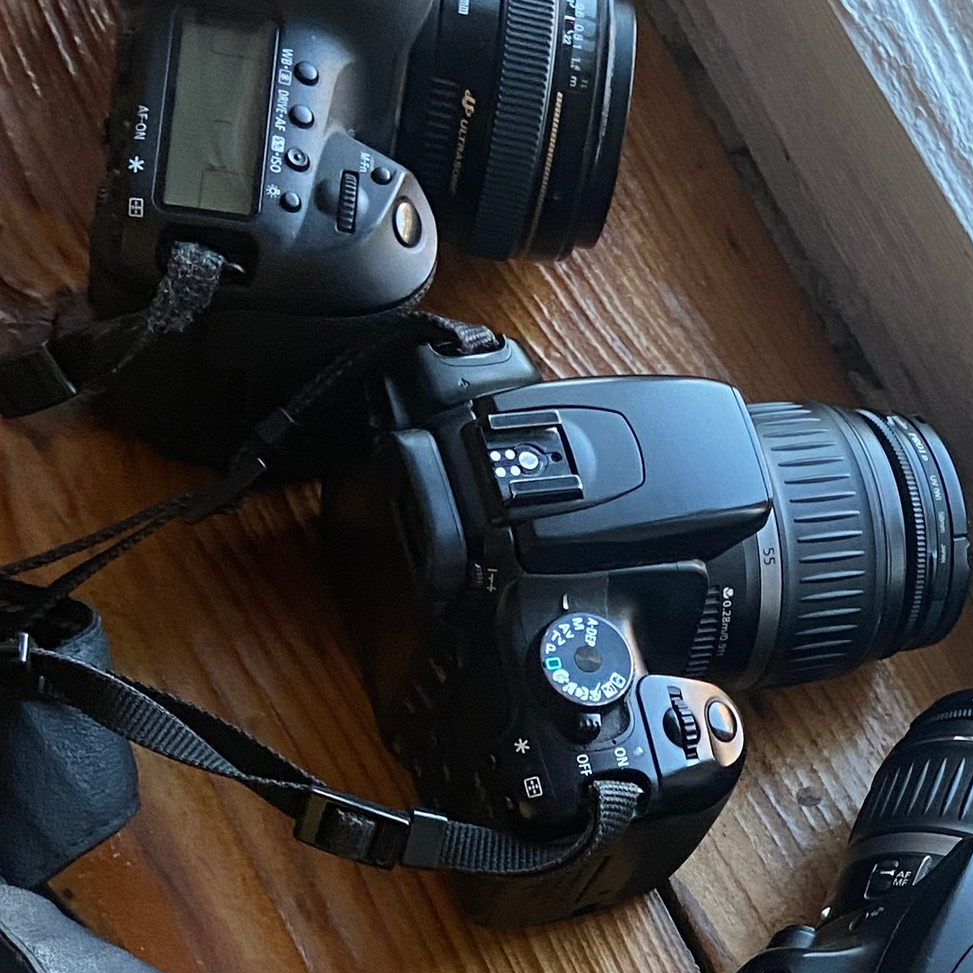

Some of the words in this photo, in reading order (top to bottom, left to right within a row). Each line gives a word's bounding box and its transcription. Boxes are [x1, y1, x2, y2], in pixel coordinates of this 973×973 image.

[134, 105, 149, 140] AF-ON
[450, 118, 469, 195] ULTRASO
[763, 547, 776, 566] 55
[559, 623, 574, 639] Av
[572, 617, 585, 631] M
[585, 617, 599, 647] A-DEP
[551, 629, 566, 646] Tv
[545, 643, 556, 654] P
[576, 754, 592, 776] OFF
[614, 747, 629, 767] ON
[892, 877, 909, 887] MF
[895, 870, 912, 879] AF
